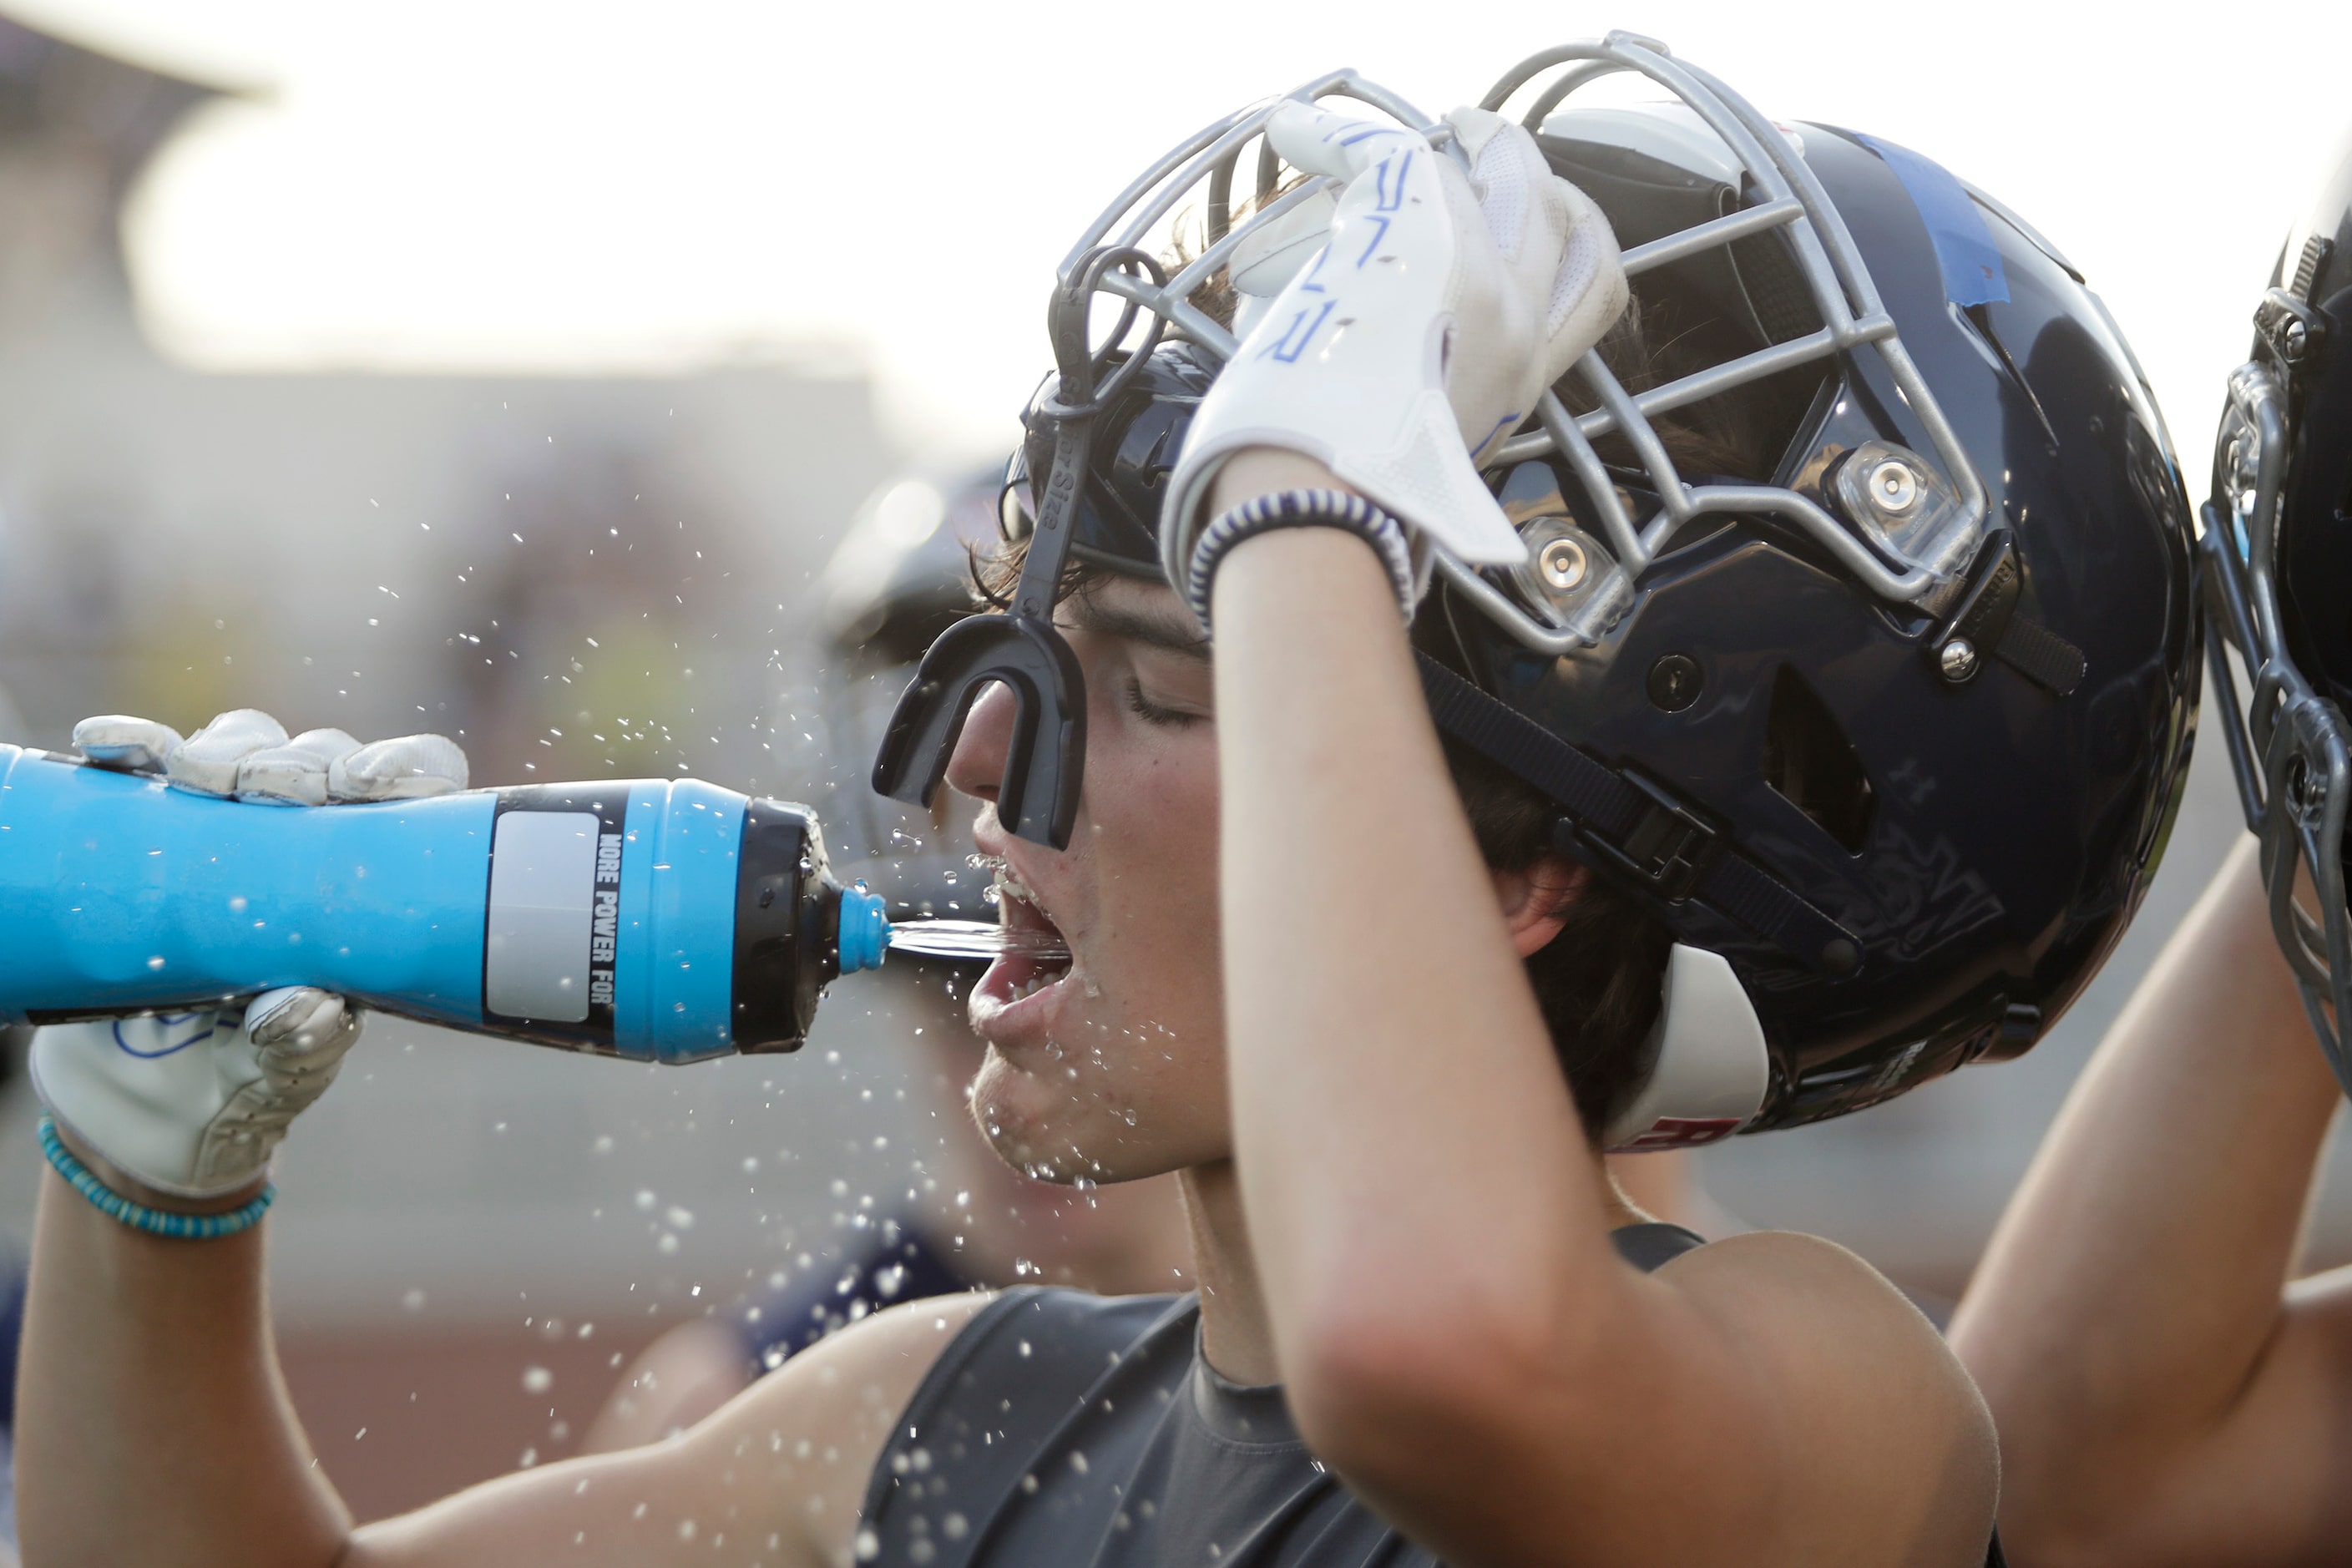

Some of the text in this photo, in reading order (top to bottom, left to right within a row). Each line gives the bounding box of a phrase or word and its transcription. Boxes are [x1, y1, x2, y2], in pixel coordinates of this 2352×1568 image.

[1043, 470, 1075, 530] Size
[590, 833, 623, 1004] MORE POWER FOR
